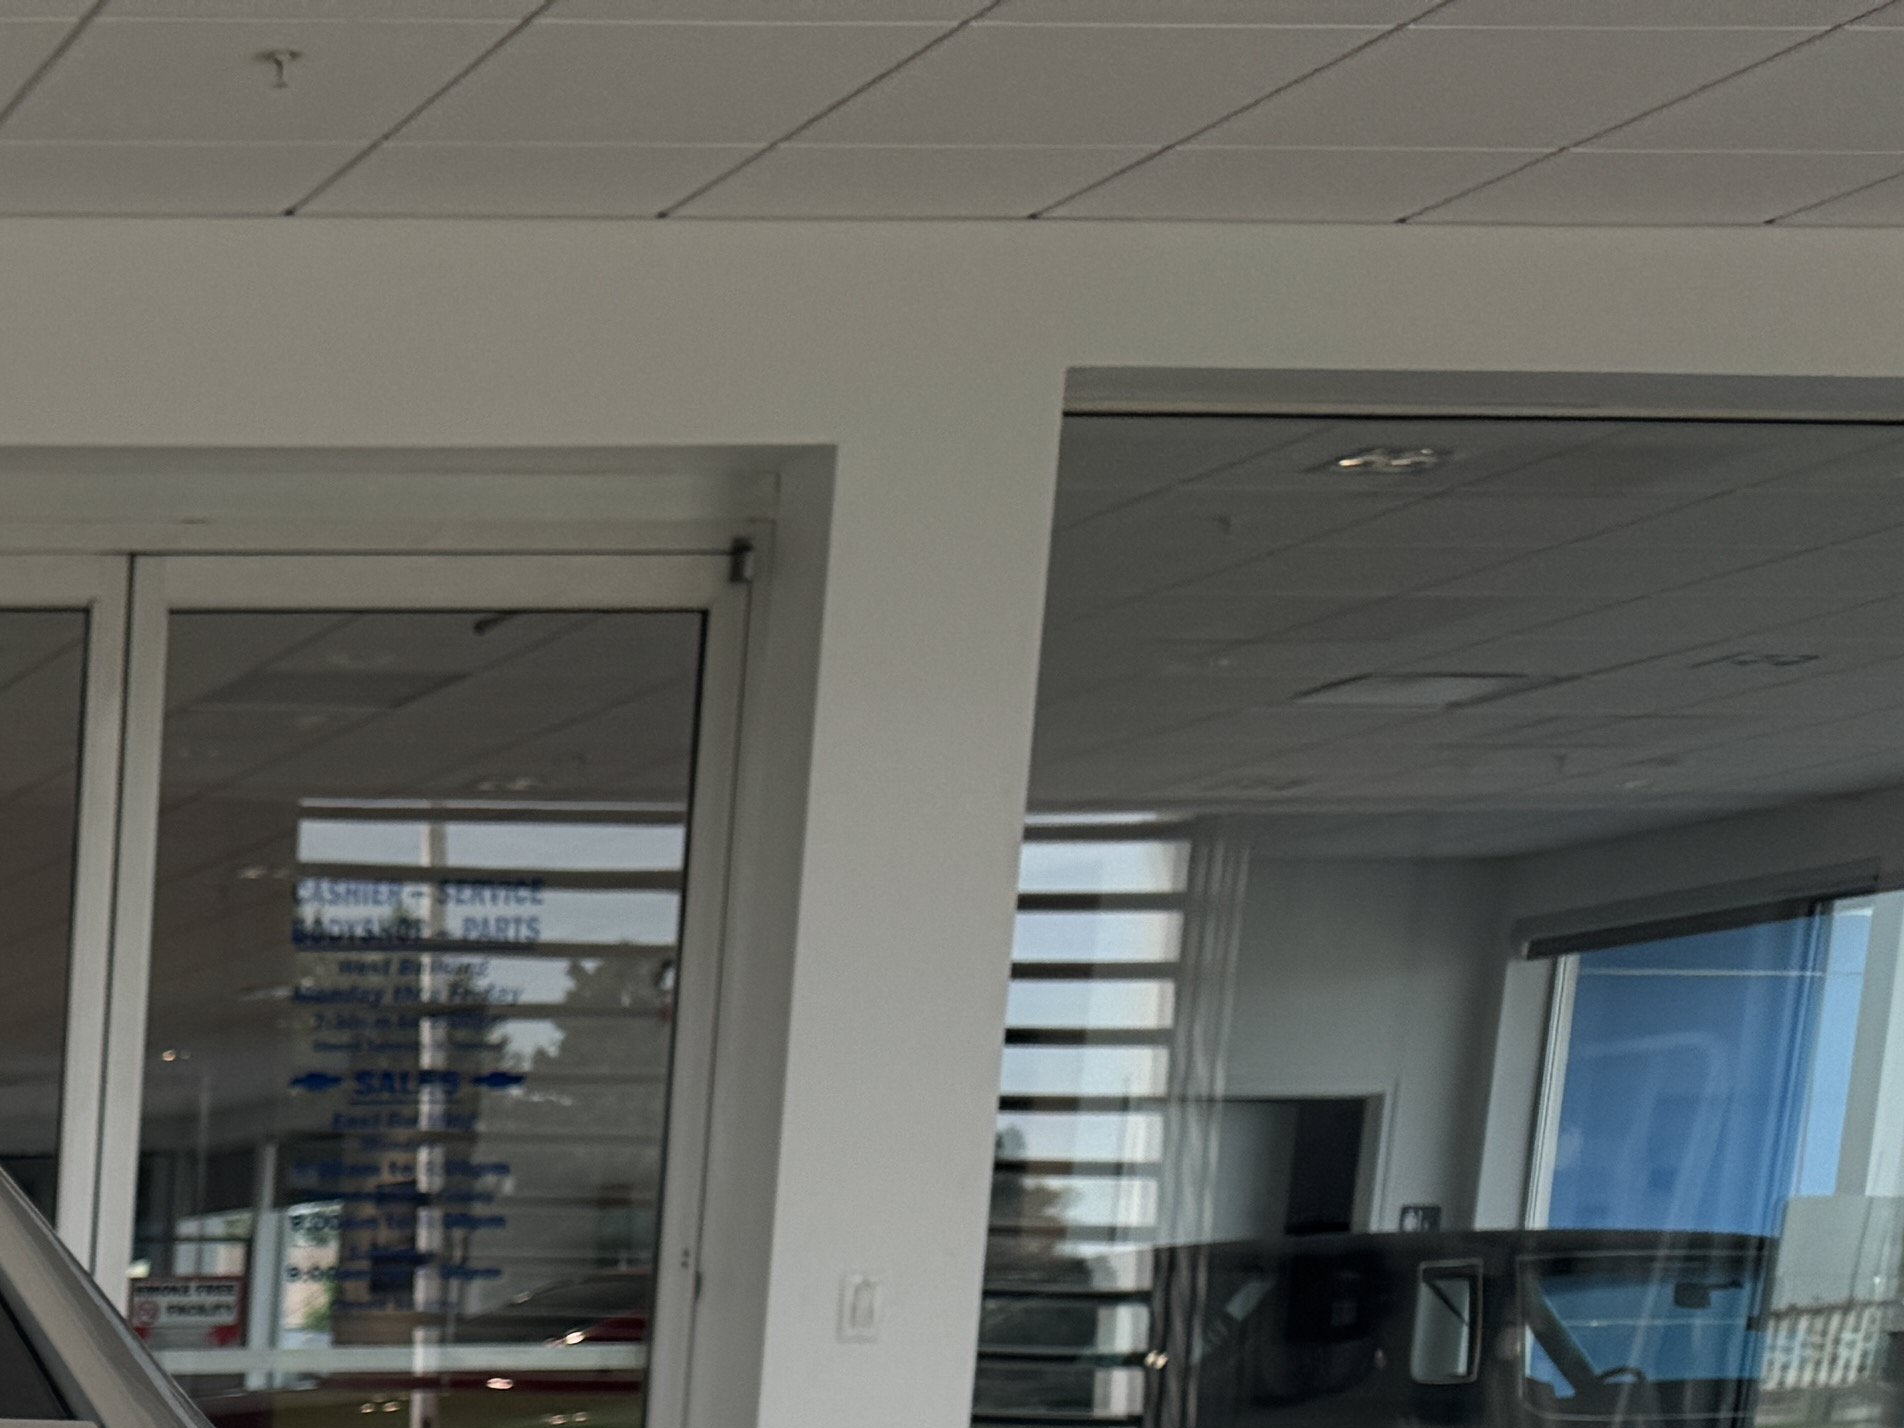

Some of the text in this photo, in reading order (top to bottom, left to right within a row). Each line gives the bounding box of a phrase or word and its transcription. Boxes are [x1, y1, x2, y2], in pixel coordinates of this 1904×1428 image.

[293, 879, 402, 906] CASHIER
[438, 878, 545, 906] SERVICE
[462, 916, 542, 943] PARTS
[354, 1070, 461, 1095] SALES
